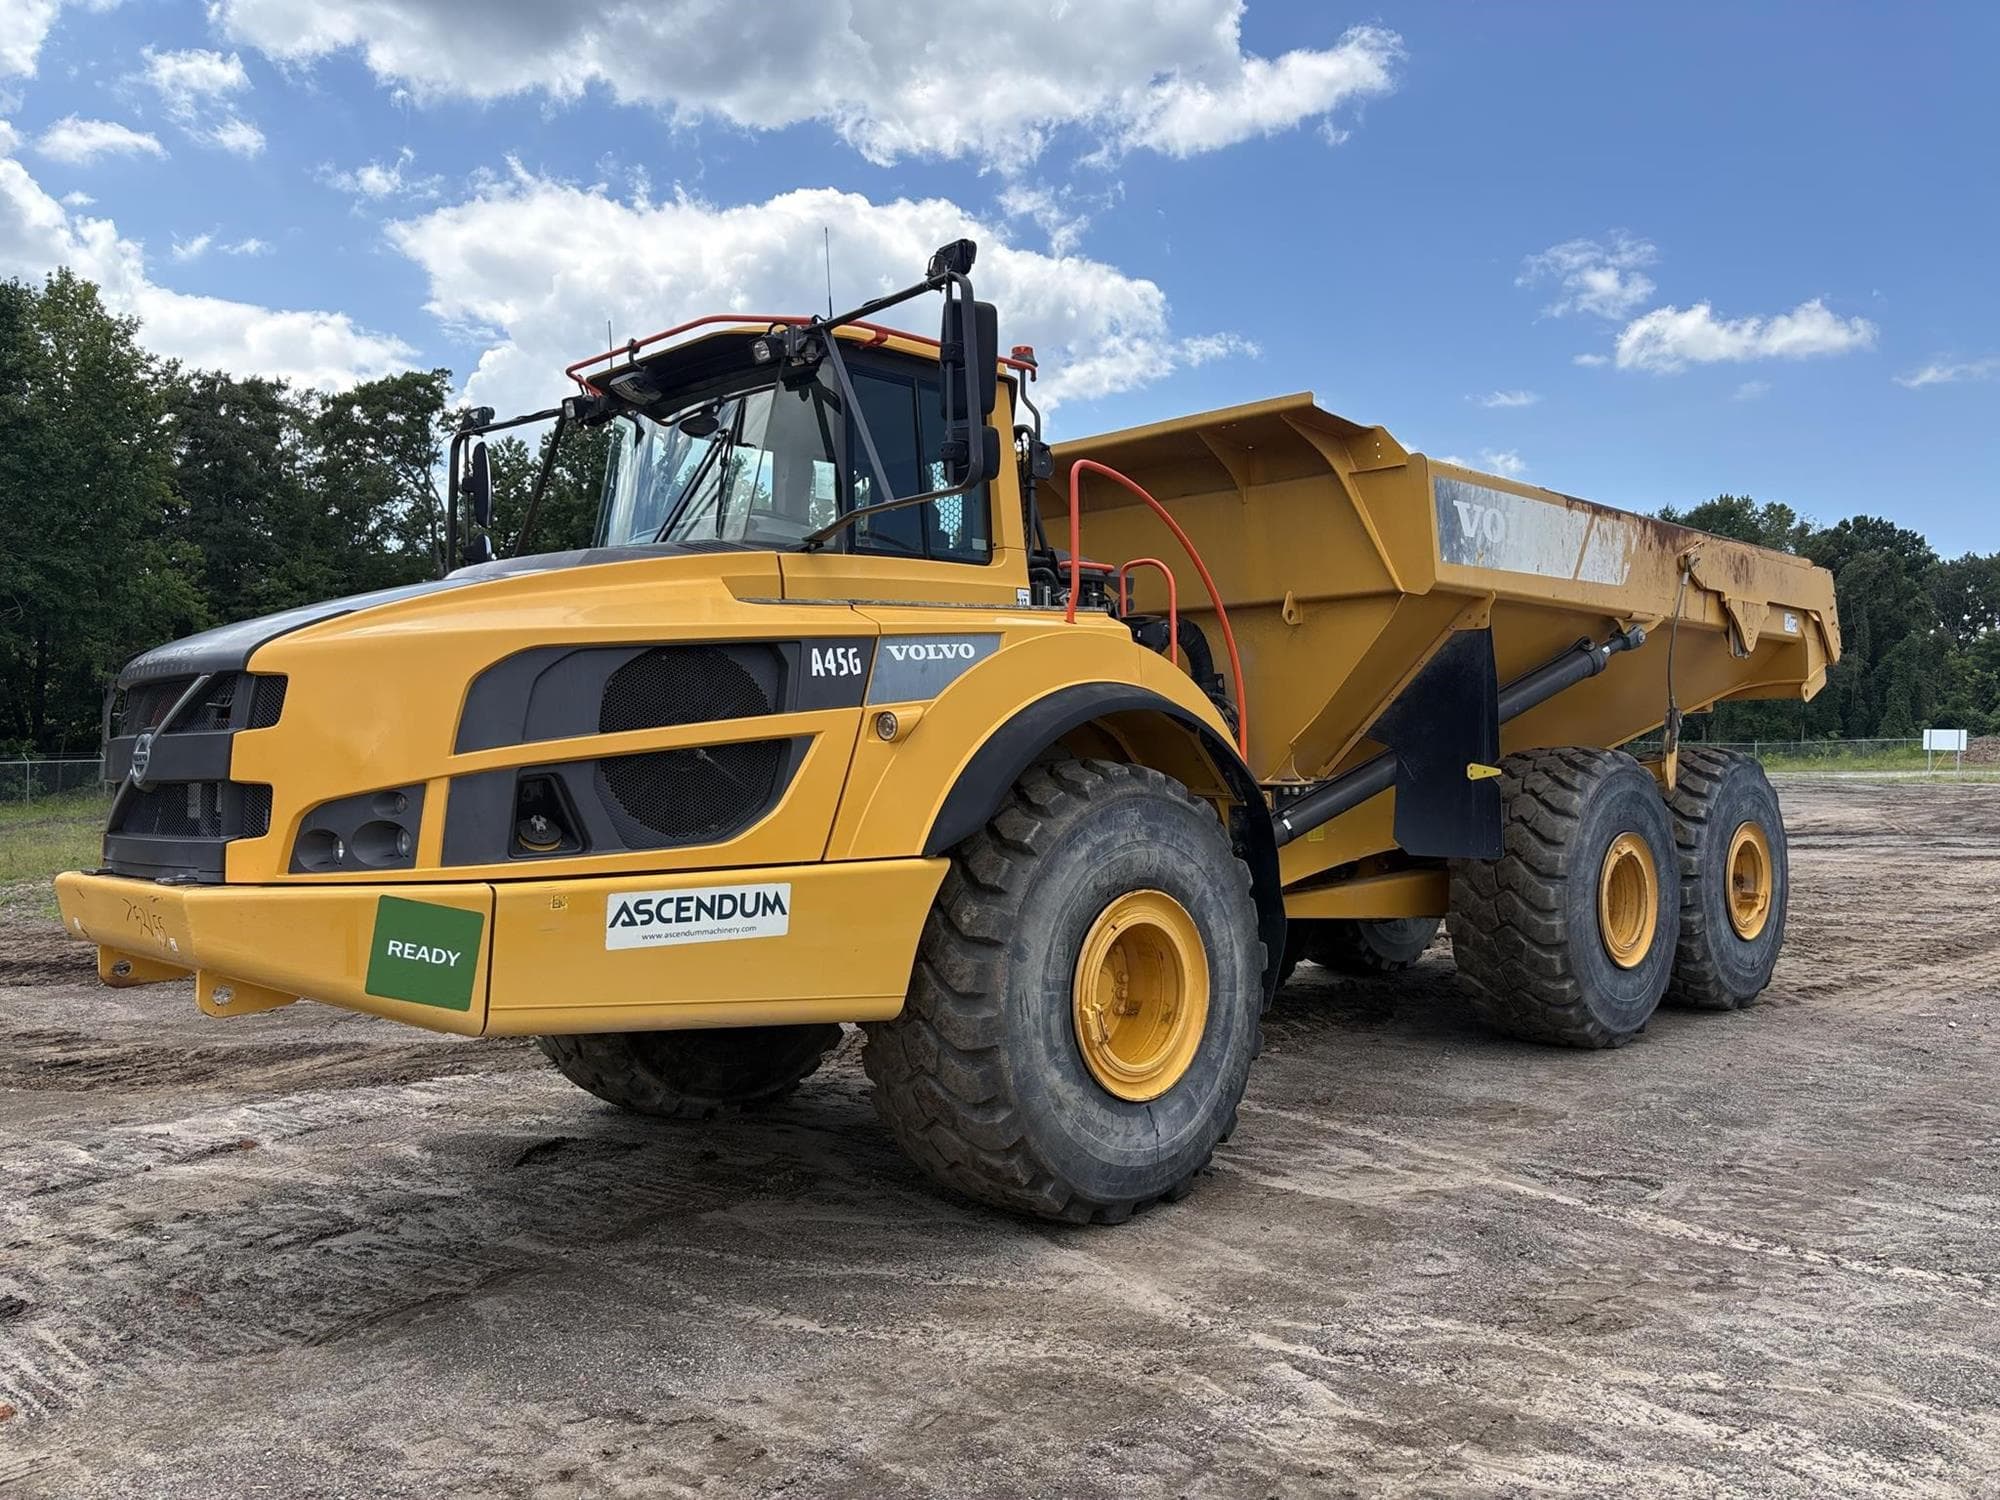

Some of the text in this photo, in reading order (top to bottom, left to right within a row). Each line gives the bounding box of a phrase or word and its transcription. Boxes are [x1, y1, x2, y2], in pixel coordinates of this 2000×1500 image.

[811, 647, 862, 677] A45G
[886, 643, 976, 661] VOLVO
[608, 890, 788, 929] ASCENDUM
[641, 925, 758, 941] www.ascendummachinery.com
[387, 939, 461, 967] READY
